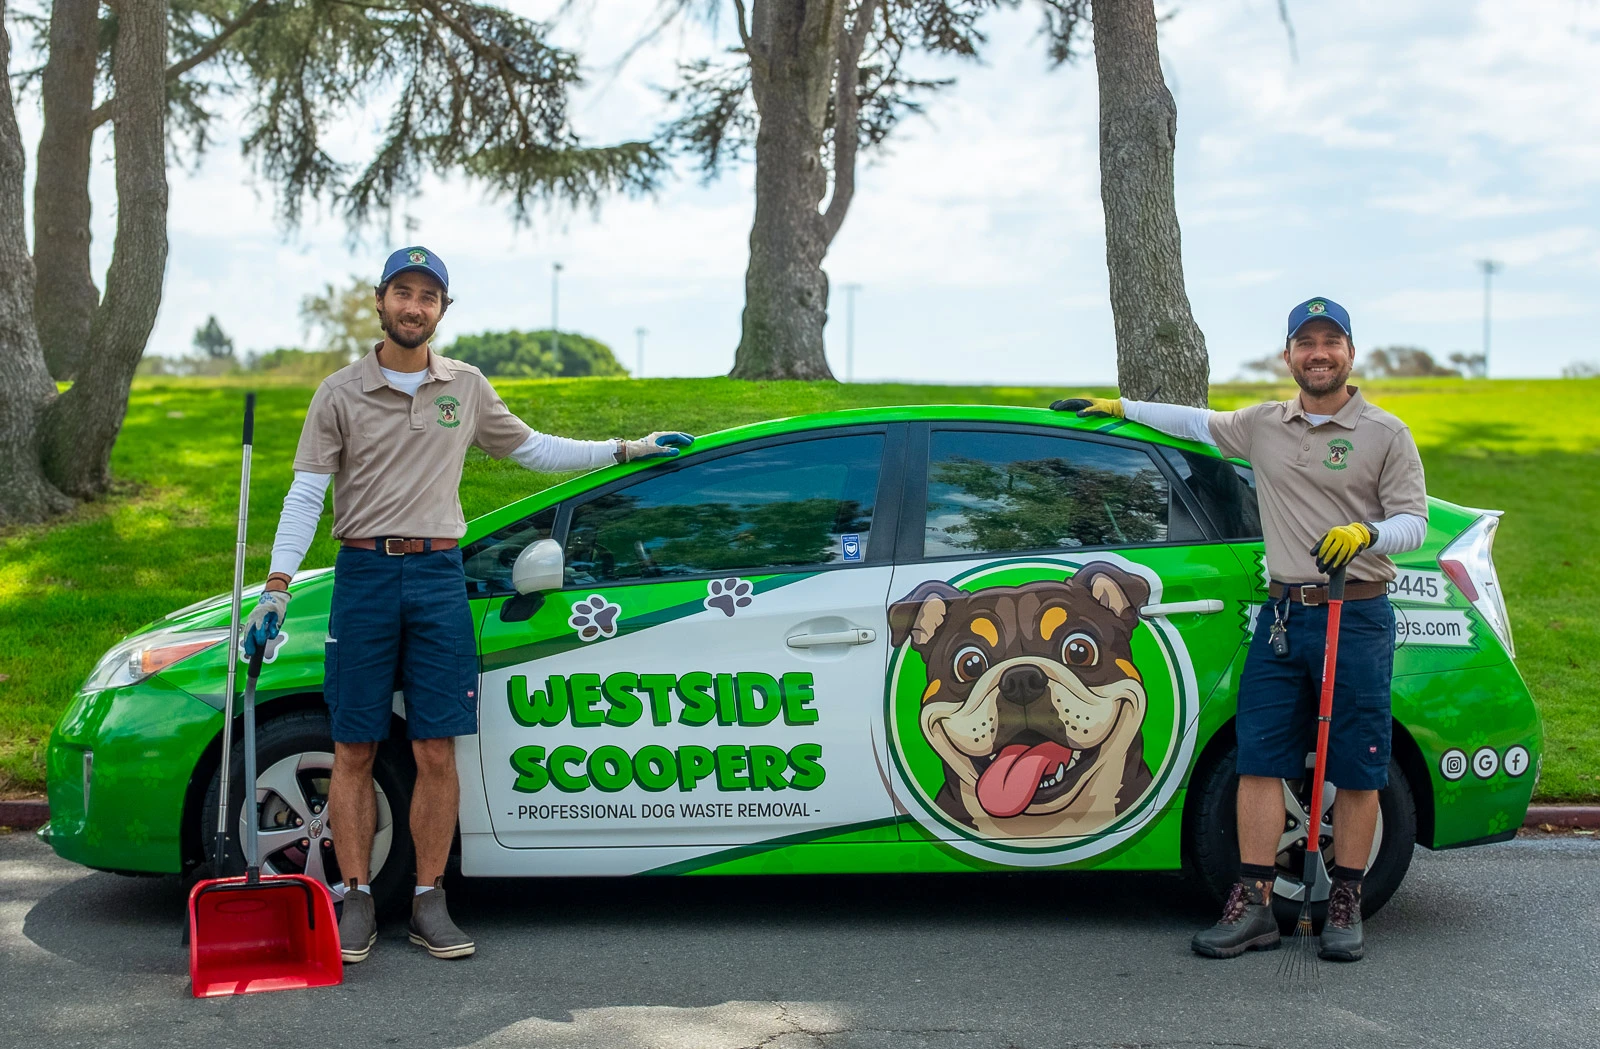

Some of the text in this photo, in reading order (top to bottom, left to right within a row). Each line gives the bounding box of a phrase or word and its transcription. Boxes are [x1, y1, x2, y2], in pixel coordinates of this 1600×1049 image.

[1396, 620, 1461, 637] ers.com
[507, 671, 819, 728] WESTSIDE
[509, 743, 826, 793] SCOOPERS
[518, 804, 637, 820] PROFESSIONAL
[641, 803, 675, 819] DOG
[680, 802, 733, 818] WASTE
[737, 802, 810, 818] REMOVAL
